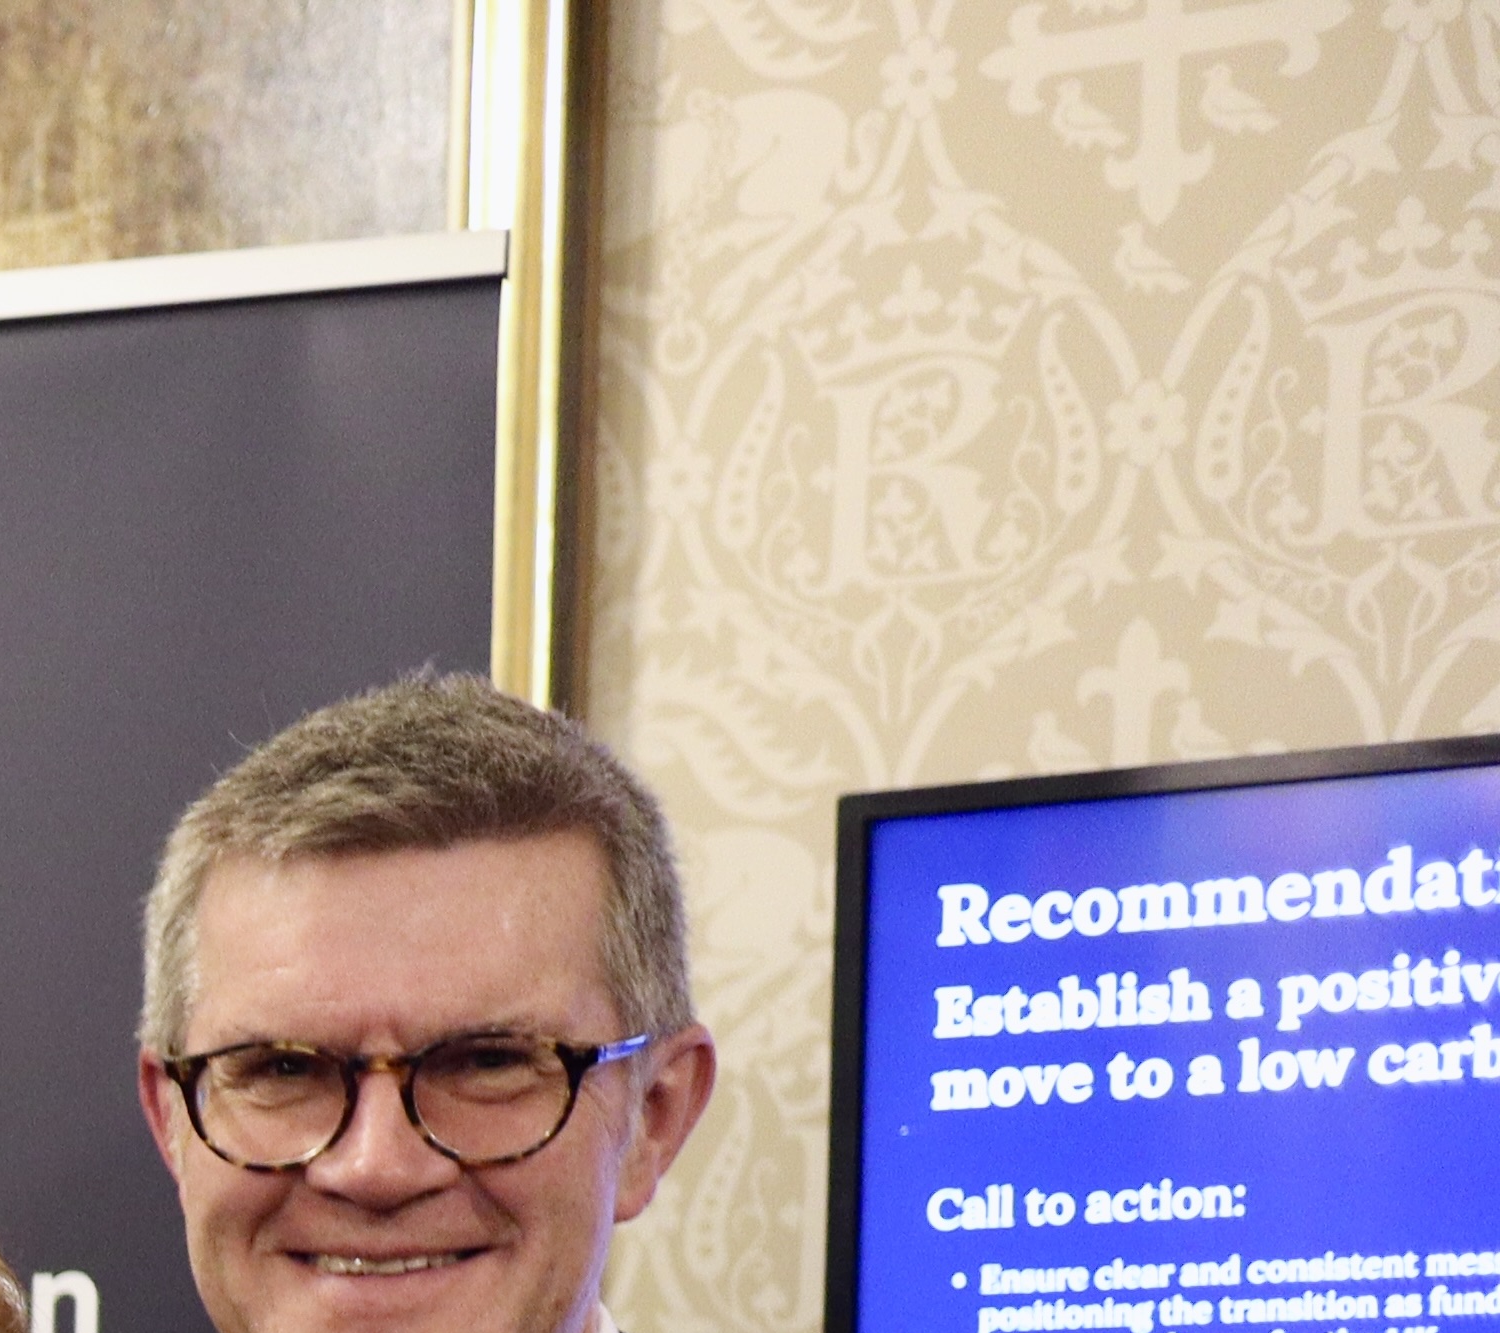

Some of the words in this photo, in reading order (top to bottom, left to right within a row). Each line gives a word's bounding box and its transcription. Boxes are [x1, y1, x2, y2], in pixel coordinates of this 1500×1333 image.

[933, 968, 1212, 1039] Establish
[1225, 977, 1263, 1018] a
[1276, 950, 1500, 1030] positiv
[930, 1062, 1094, 1111] move
[1107, 1052, 1173, 1100] to
[1187, 1053, 1224, 1096] a
[1237, 1037, 1355, 1093] low
[1367, 1024, 1500, 1085] carb
[926, 1183, 1015, 1231] Call
[1025, 1188, 1076, 1227] to
[1084, 1178, 1247, 1224] action:
[979, 1263, 1090, 1295] Ensure
[1093, 1257, 1176, 1291] clear
[1179, 1253, 1241, 1287] and
[1246, 1251, 1420, 1284] consistent
[1424, 1251, 1500, 1277] mes
[1158, 1294, 1214, 1326] the
[1219, 1290, 1379, 1324] transition
[1384, 1294, 1423, 1318] as
